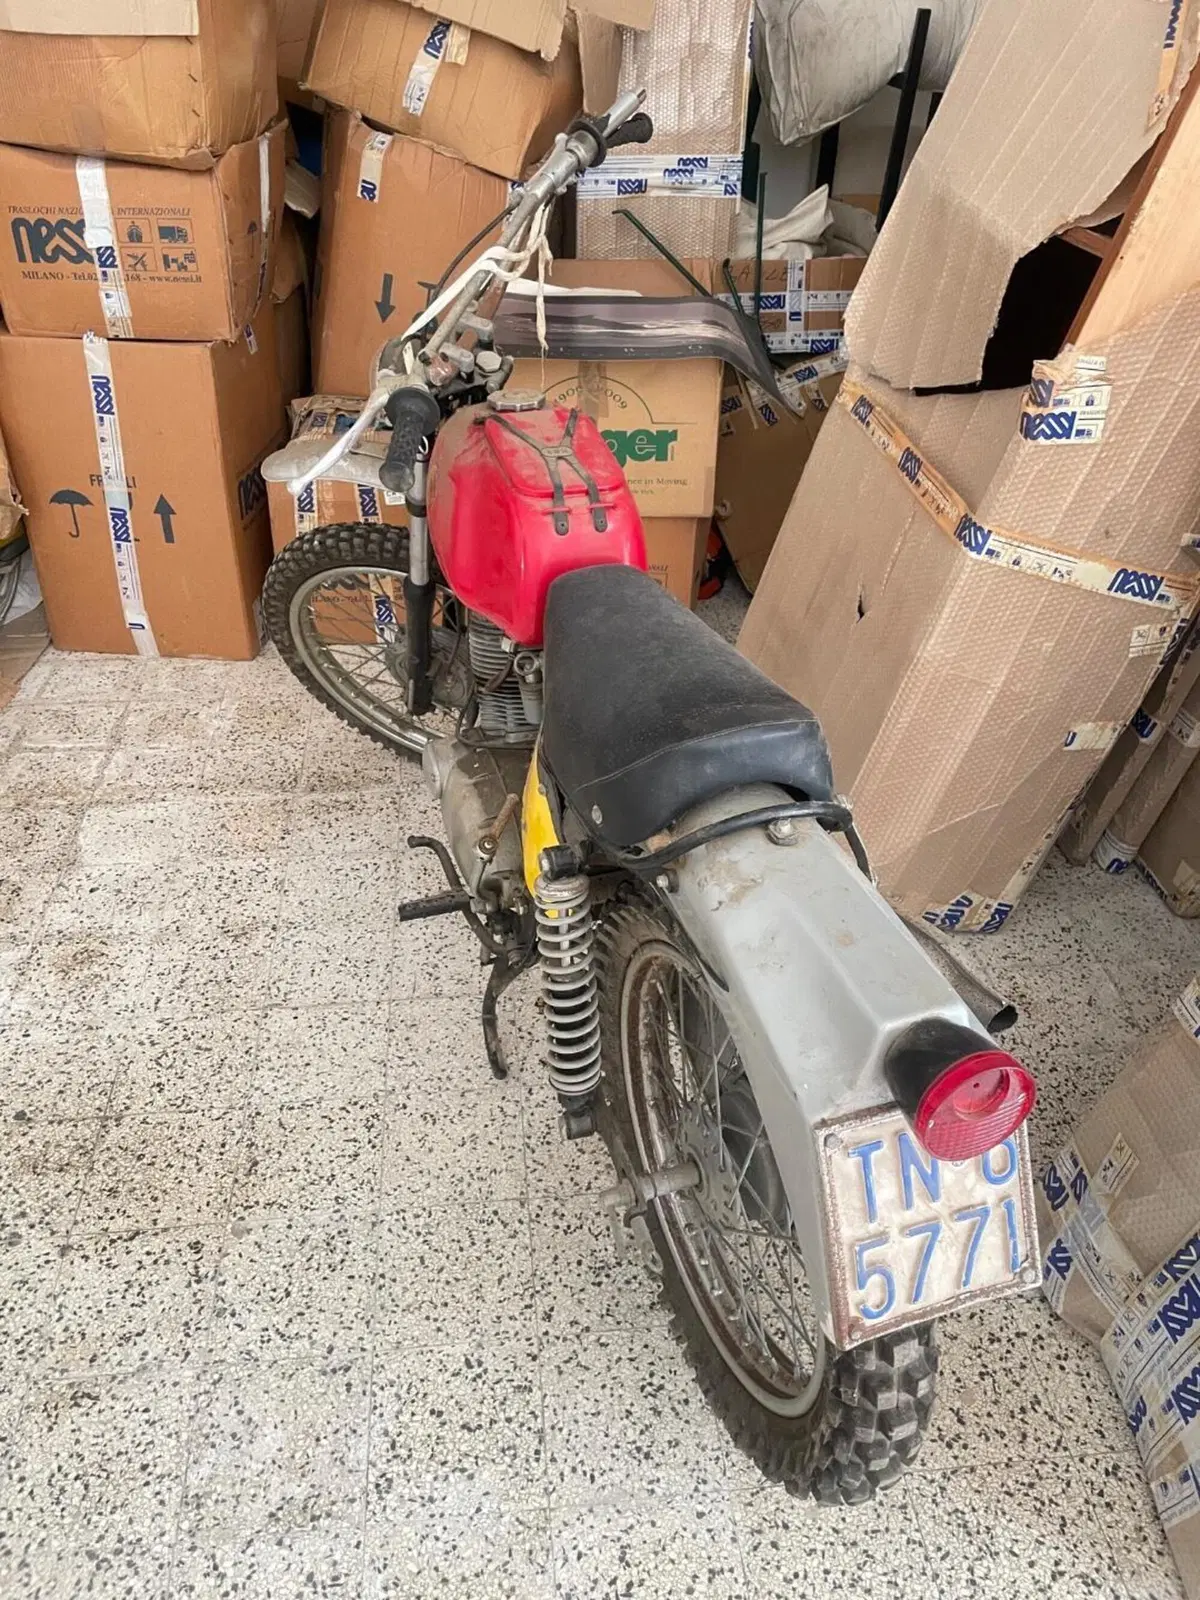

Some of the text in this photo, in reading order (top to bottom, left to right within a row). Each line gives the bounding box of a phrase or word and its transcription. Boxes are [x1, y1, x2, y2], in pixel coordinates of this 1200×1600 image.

[8, 205, 56, 214] TRASLOCHI
[117, 207, 191, 217] INTERNAZIONALI
[22, 271, 64, 281] MILANO
[848, 1132, 942, 1223] TN
[855, 1199, 1020, 1319] 5771
